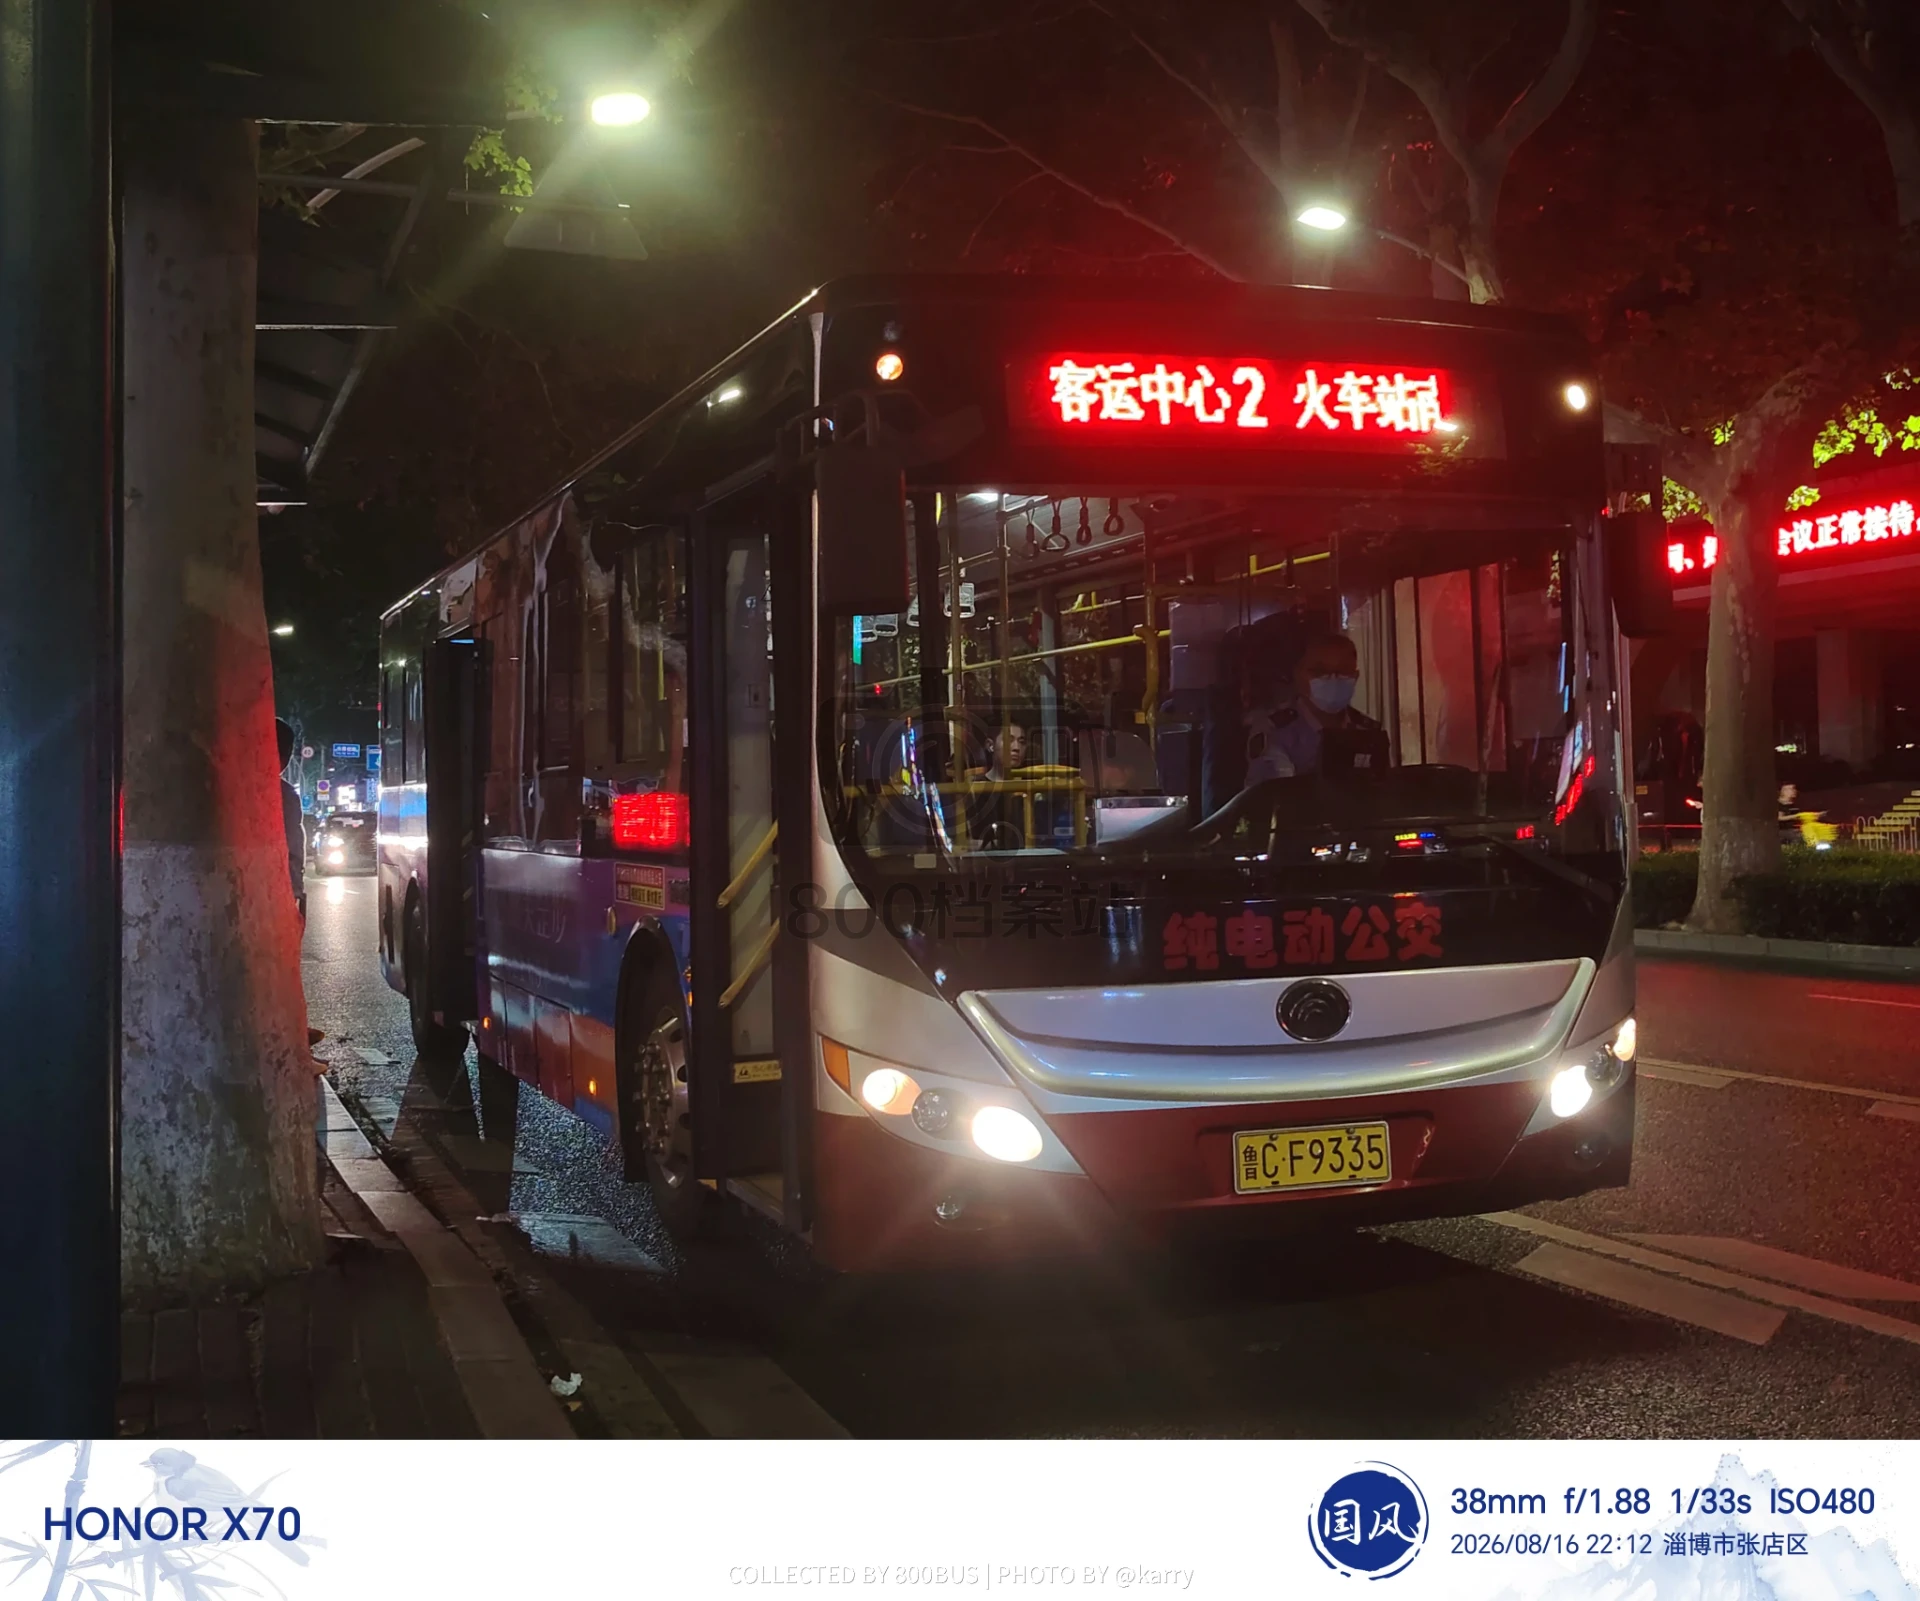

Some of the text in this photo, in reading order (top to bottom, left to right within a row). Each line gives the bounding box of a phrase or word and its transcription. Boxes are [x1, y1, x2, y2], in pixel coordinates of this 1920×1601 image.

[1162, 902, 1443, 970] 纯电动公交
